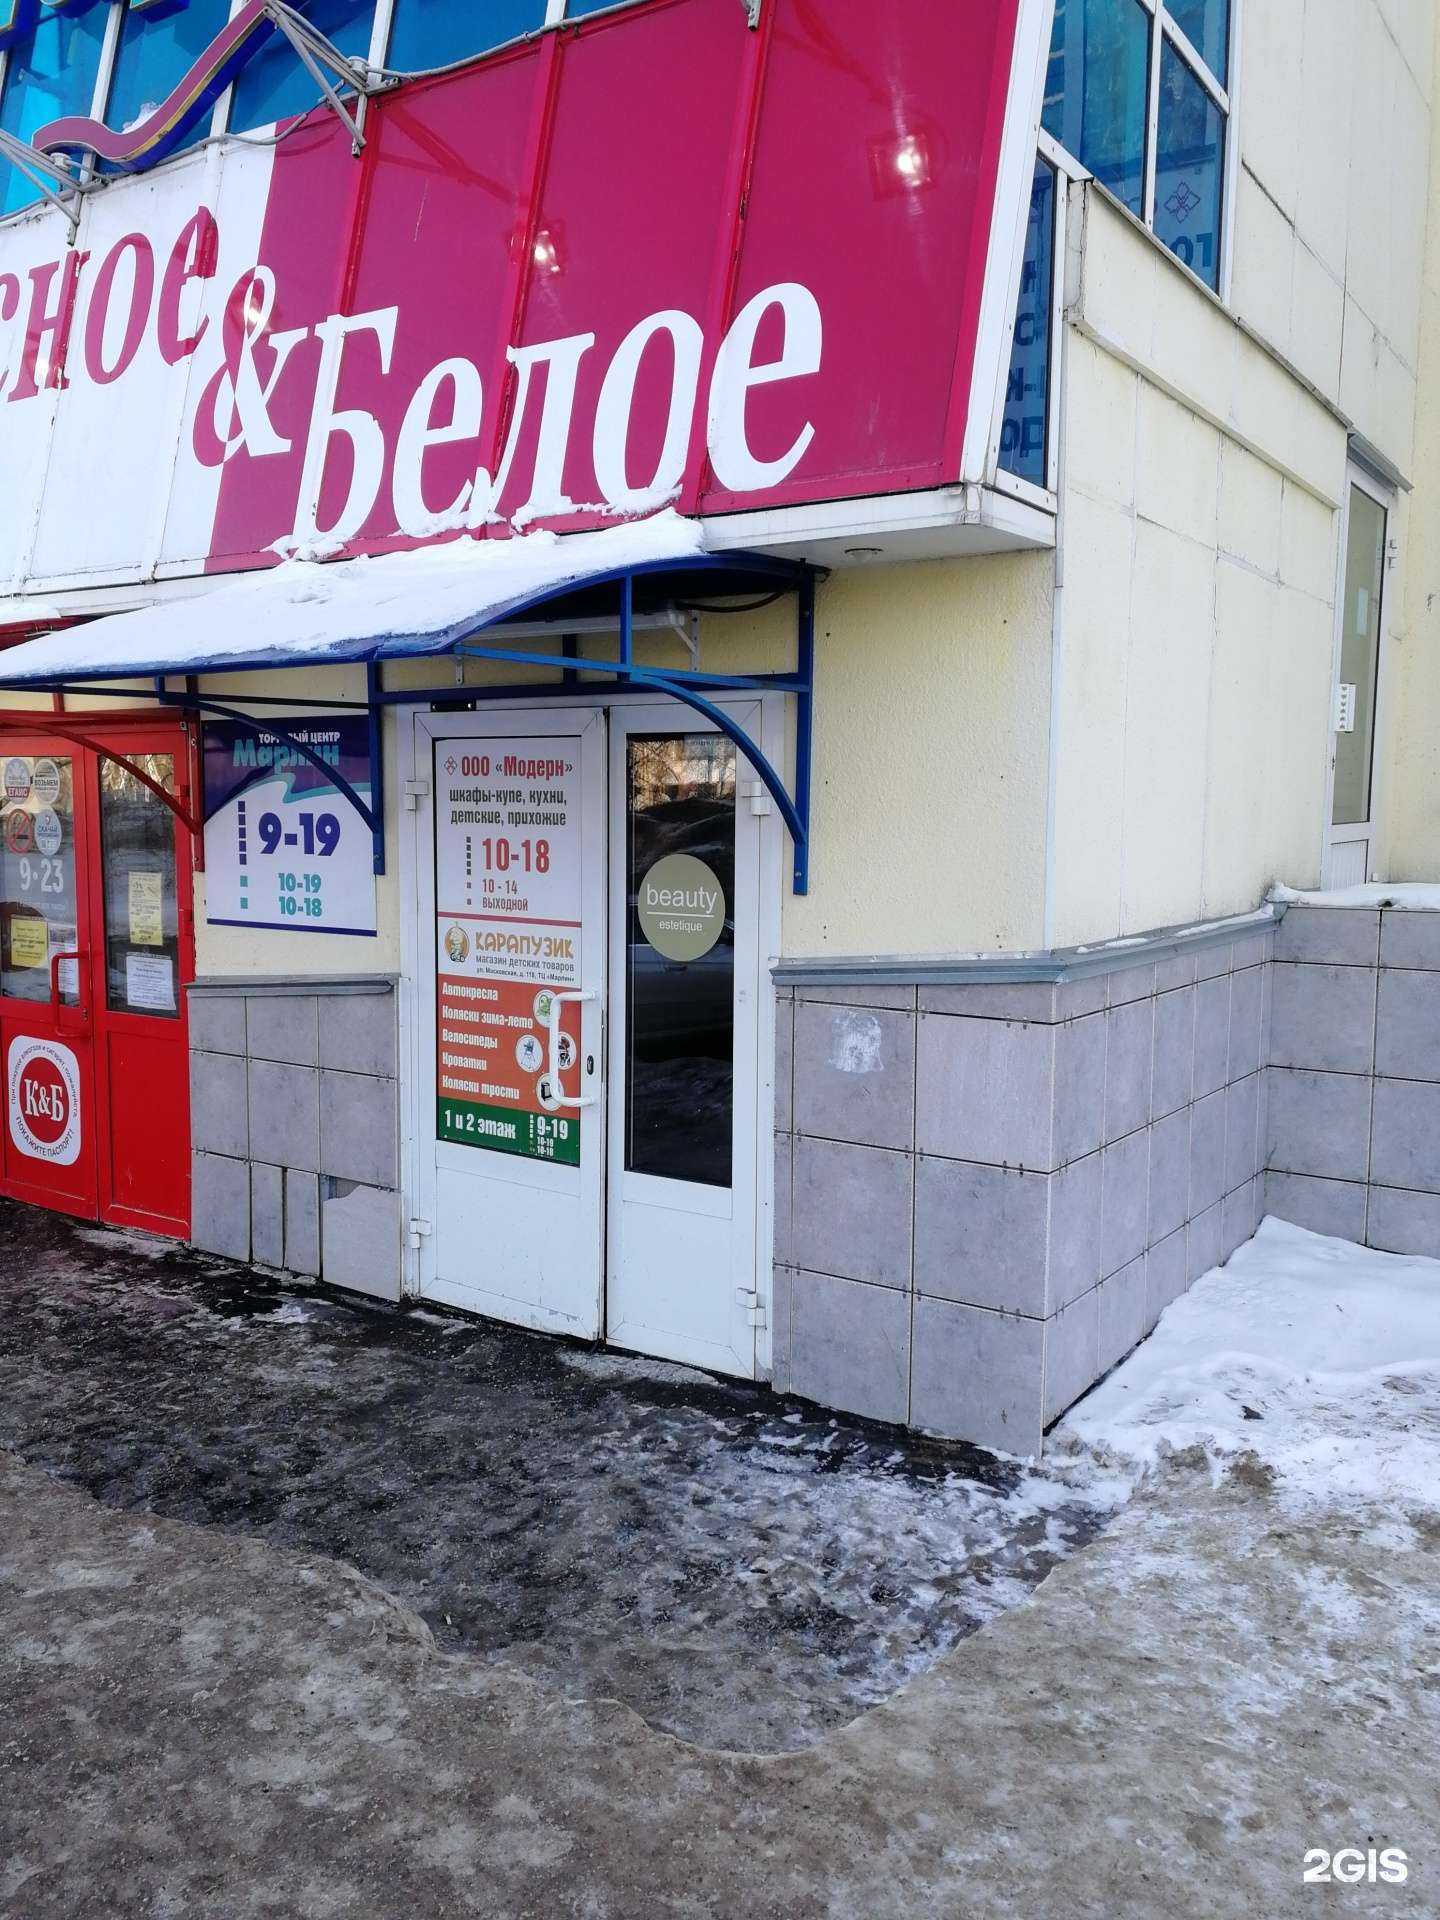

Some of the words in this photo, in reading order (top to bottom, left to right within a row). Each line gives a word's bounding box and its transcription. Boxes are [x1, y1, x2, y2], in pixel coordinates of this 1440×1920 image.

[292, 282, 822, 546] Белое
[259, 730, 309, 745] ТОРЫЙ
[310, 731, 341, 745] ЦЕНТР
[461, 756, 490, 777] ООО
[495, 755, 573, 781] «Модерн»
[450, 787, 526, 807] шкафы-купе,
[529, 789, 567, 807] кухни,
[450, 809, 504, 827] детские,
[507, 812, 567, 828] прихожие
[258, 812, 341, 857] 9-19
[482, 838, 550, 874] 10-18
[278, 873, 322, 893] 10-19
[278, 896, 323, 917] 10-18
[646, 884, 717, 914] beauty
[659, 919, 703, 934] estetique
[475, 932, 574, 959] КАРАПУЗИК
[508, 957, 540, 968] детских
[543, 961, 575, 973] товаров
[442, 982, 499, 1002] Автокресла
[442, 1005, 480, 1024] Коляски
[481, 1011, 533, 1030] зима-лето
[442, 1028, 498, 1049] Велосипеды
[442, 1052, 487, 1071] Кроватки
[442, 1075, 479, 1093] Коляски
[481, 1083, 520, 1099] трости
[24, 1078, 64, 1122] К&Б
[445, 1109, 451, 1127] 1
[455, 1114, 463, 1130] и
[466, 1113, 475, 1131] 2
[477, 1118, 516, 1139] этаж
[537, 1116, 568, 1140] 9-19
